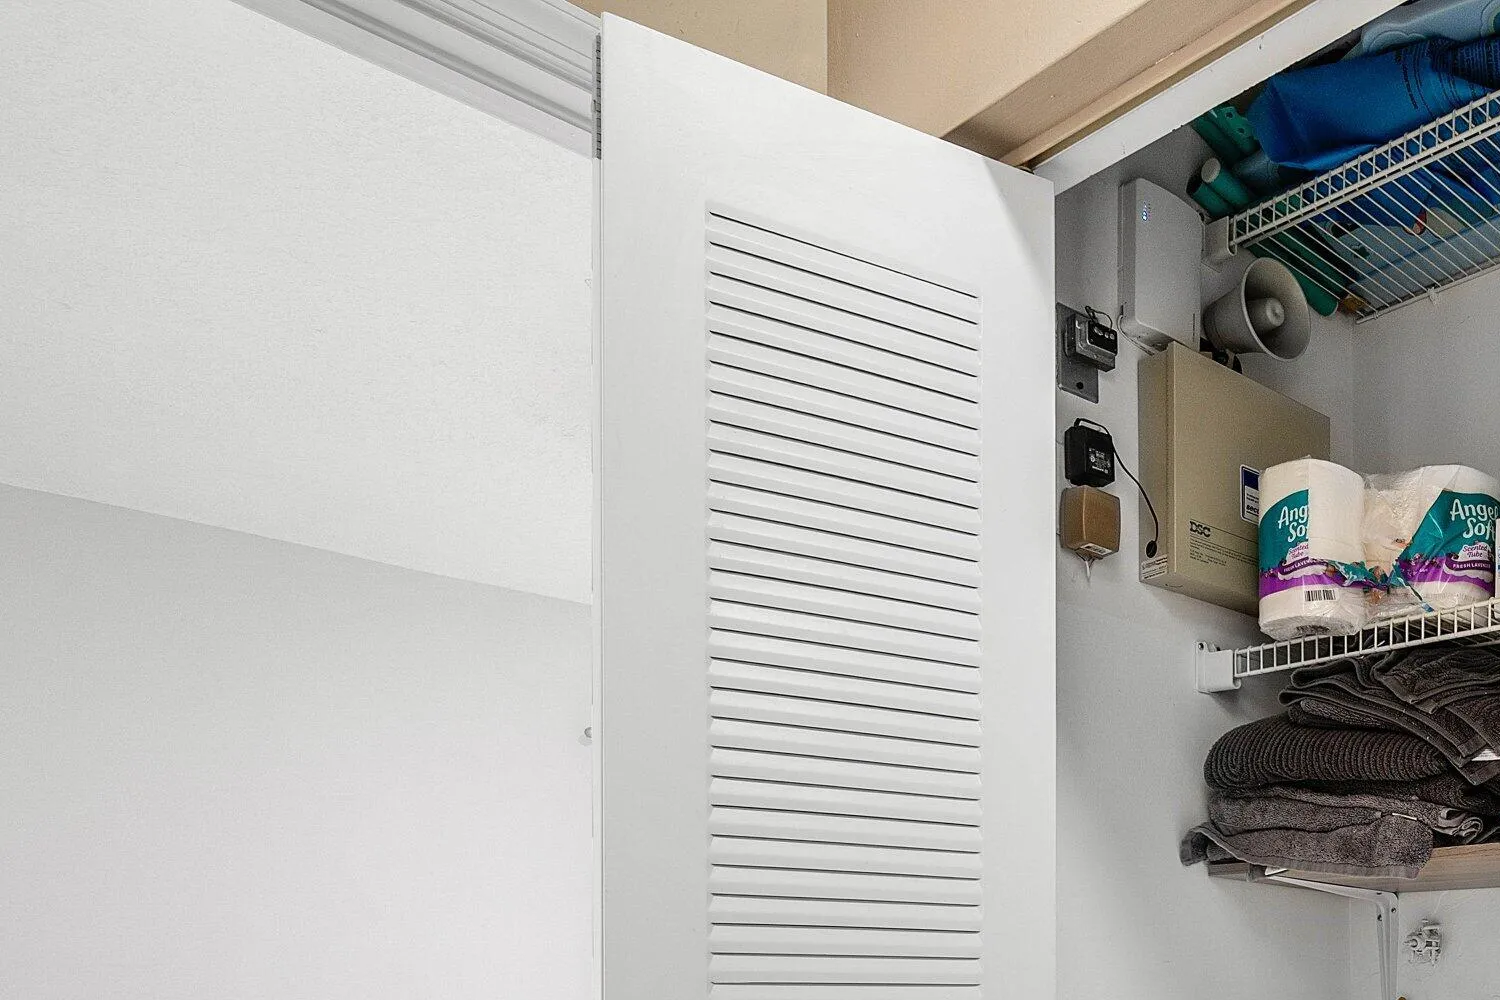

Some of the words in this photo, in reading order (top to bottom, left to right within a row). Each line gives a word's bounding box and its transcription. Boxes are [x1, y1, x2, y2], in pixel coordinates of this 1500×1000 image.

[1278, 505, 1308, 529] Ang
[1450, 499, 1498, 520] Angel
[1190, 520, 1210, 538] DSC
[1288, 522, 1308, 542] So
[1462, 544, 1488, 552] Scented
